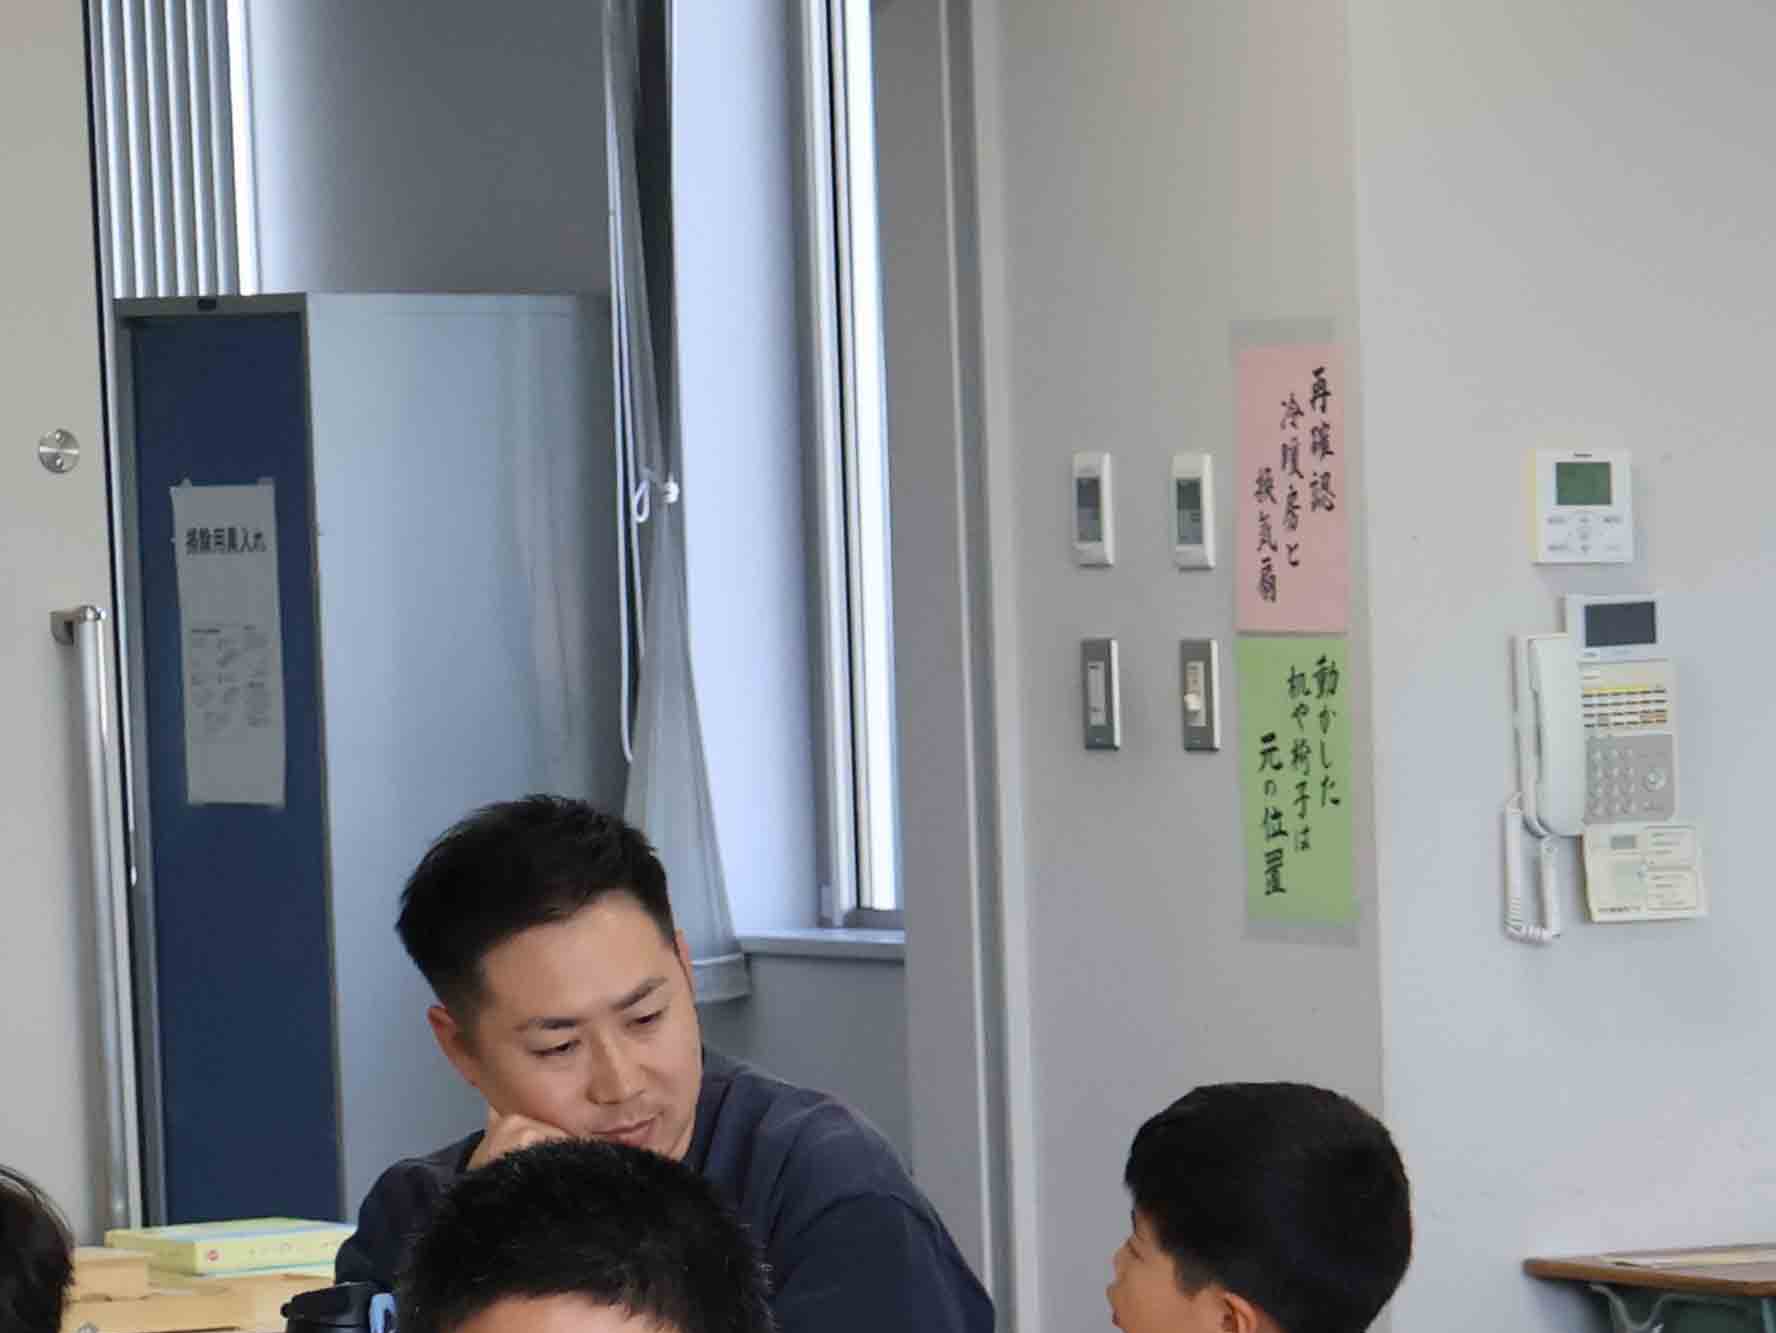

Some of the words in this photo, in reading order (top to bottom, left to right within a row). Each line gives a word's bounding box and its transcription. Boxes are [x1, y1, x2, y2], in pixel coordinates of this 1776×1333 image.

[1309, 365, 1336, 513] 再確認
[1287, 664, 1313, 852] 机や椅子は
[1312, 652, 1341, 809] 動かした
[1257, 731, 1289, 897] 元の位置
